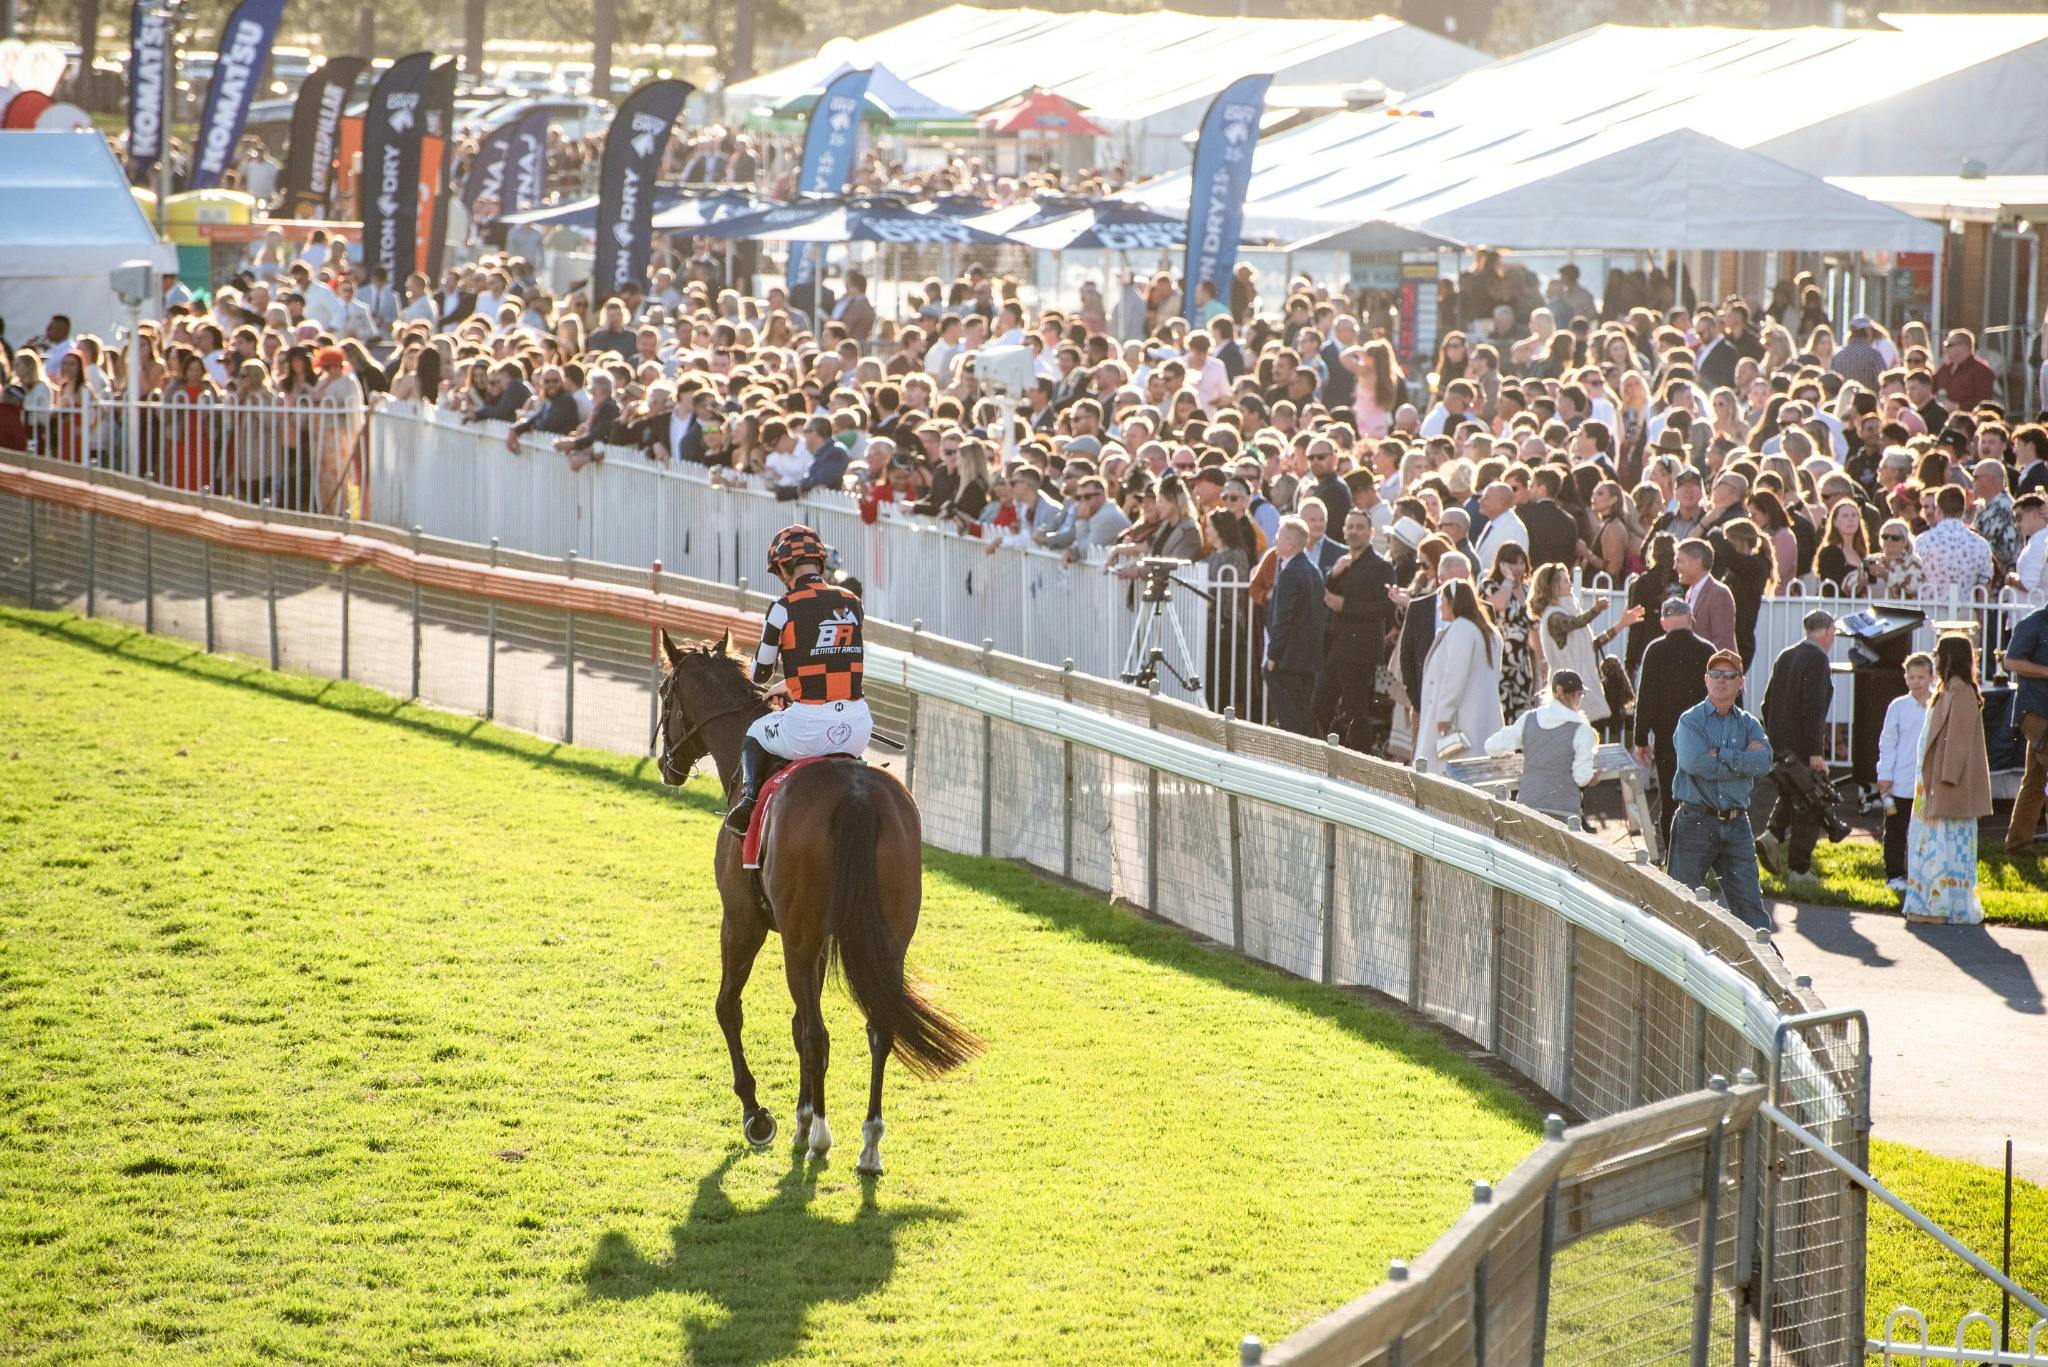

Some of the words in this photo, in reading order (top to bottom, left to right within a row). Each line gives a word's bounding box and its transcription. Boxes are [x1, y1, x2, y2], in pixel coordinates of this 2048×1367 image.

[201, 20, 264, 174] KOMATSU
[381, 143, 400, 194] DRY
[620, 167, 640, 222] DRY
[1090, 222, 1188, 235] CARLTO
[1202, 197, 1226, 253] DRY
[810, 647, 841, 656] BENNETT
[842, 646, 862, 654] RACING
